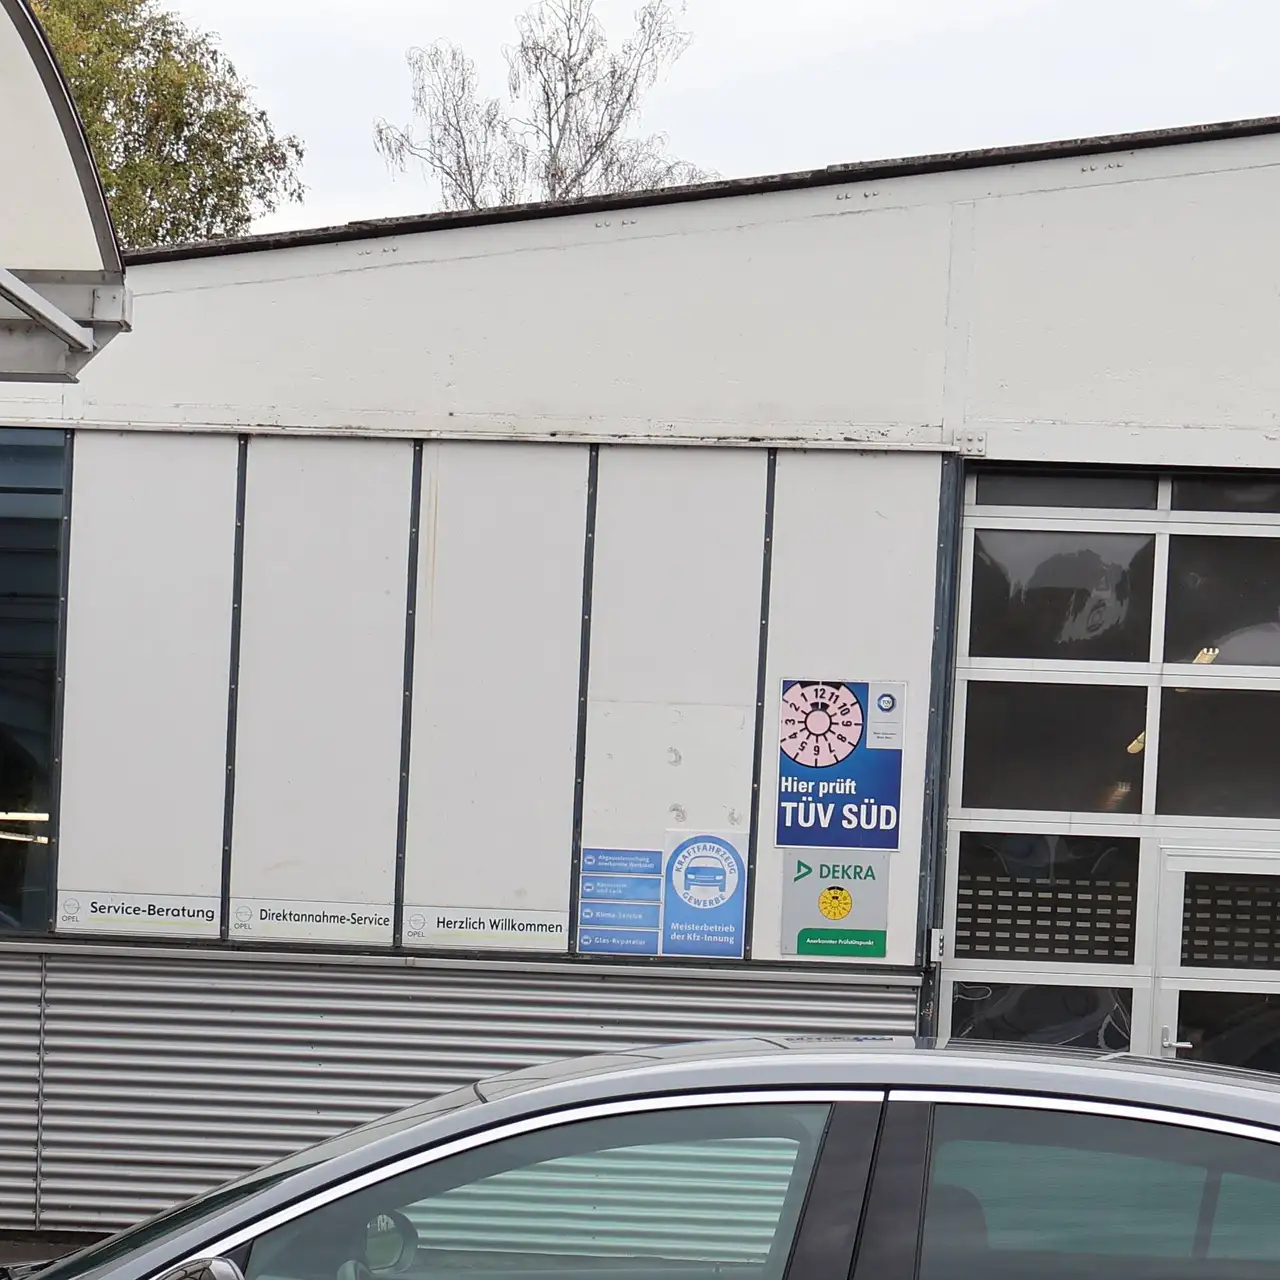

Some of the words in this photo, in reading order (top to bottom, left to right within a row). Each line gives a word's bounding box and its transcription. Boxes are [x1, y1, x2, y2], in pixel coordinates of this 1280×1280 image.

[781, 776, 815, 793] Hier
[819, 779, 856, 797] prüft
[781, 797, 835, 828] TÜV
[842, 798, 897, 830] SÜD
[675, 844, 736, 875] KRAFTFAHRZEUG
[819, 864, 876, 880] DEKRA
[682, 891, 726, 908] GEWERBE
[90, 902, 215, 920] Service-Beratung
[259, 908, 390, 926] Direktannahme-Service
[234, 922, 252, 930] OPEL
[436, 917, 485, 930] Herzlich
[489, 919, 563, 933] Willkommen
[671, 922, 735, 933] Meisterbetrieb
[671, 932, 685, 941] der
[686, 932, 735, 944] Kfz-Innung
